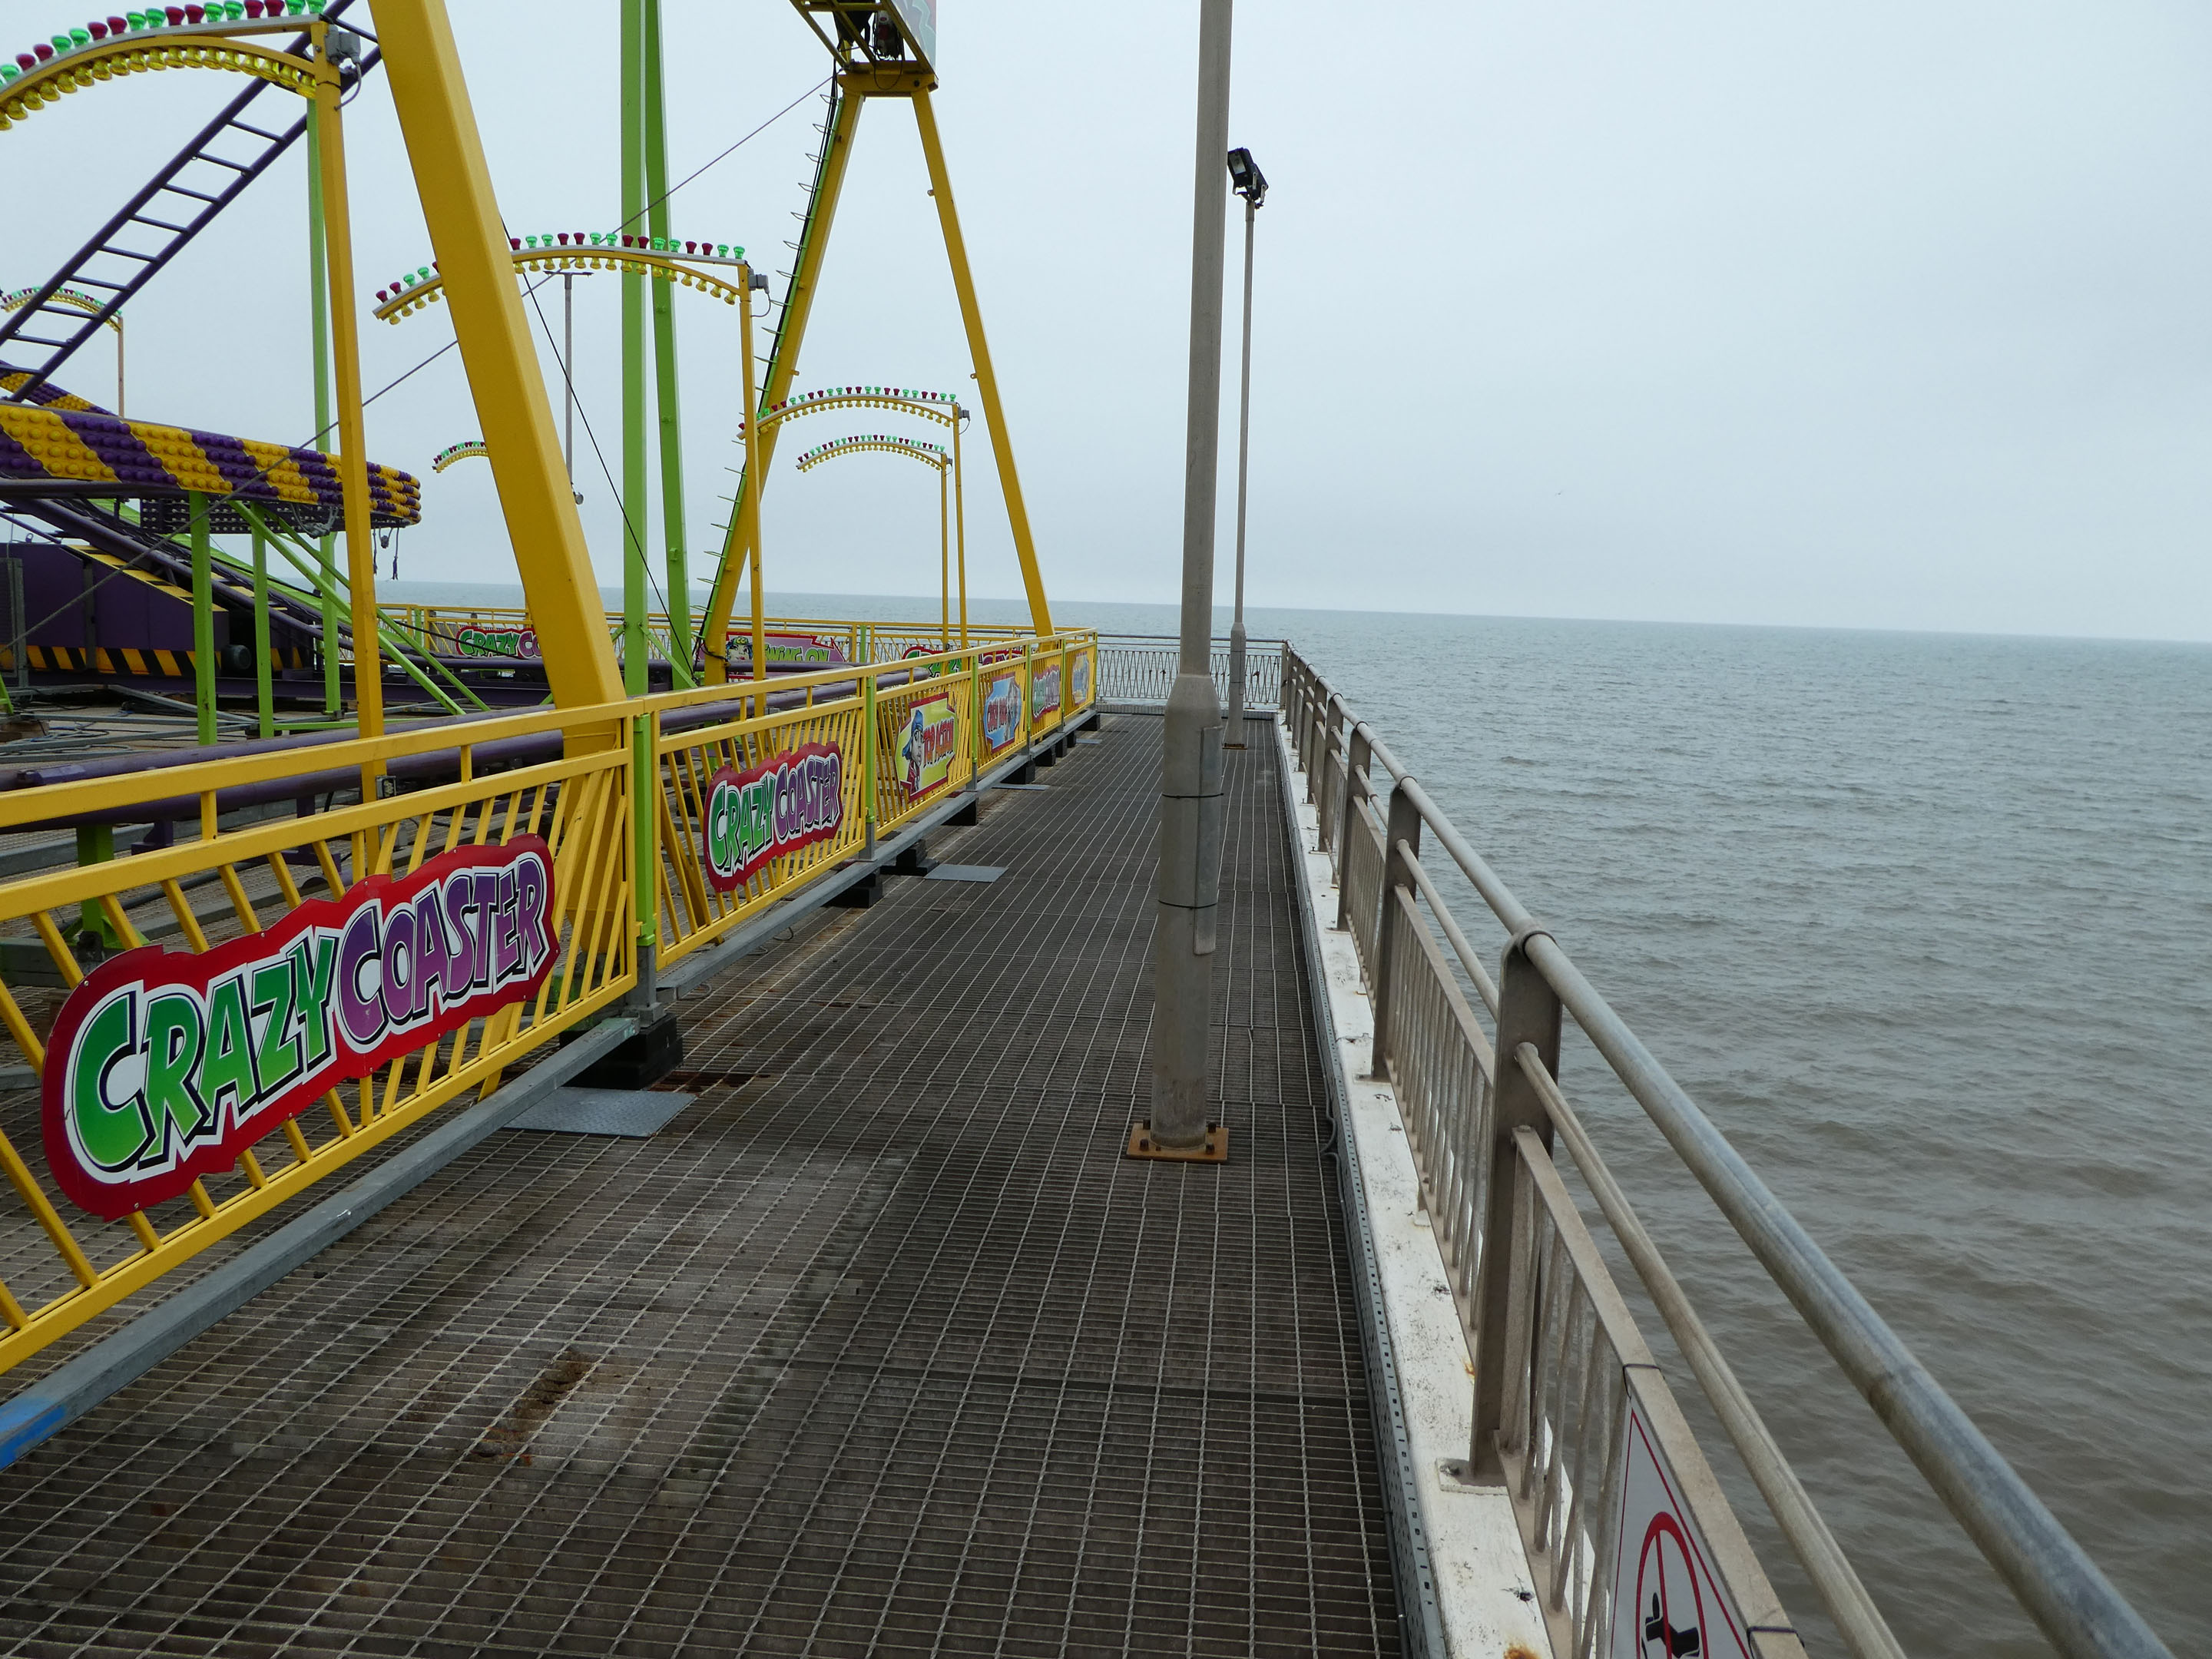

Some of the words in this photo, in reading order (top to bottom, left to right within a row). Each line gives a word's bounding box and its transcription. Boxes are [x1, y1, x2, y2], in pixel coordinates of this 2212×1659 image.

[459, 630, 520, 657] CRAZY
[710, 774, 776, 873] CRAZY
[774, 755, 840, 840] COASTER
[71, 932, 339, 1174] CRAZY
[336, 853, 549, 1045] COASTER
